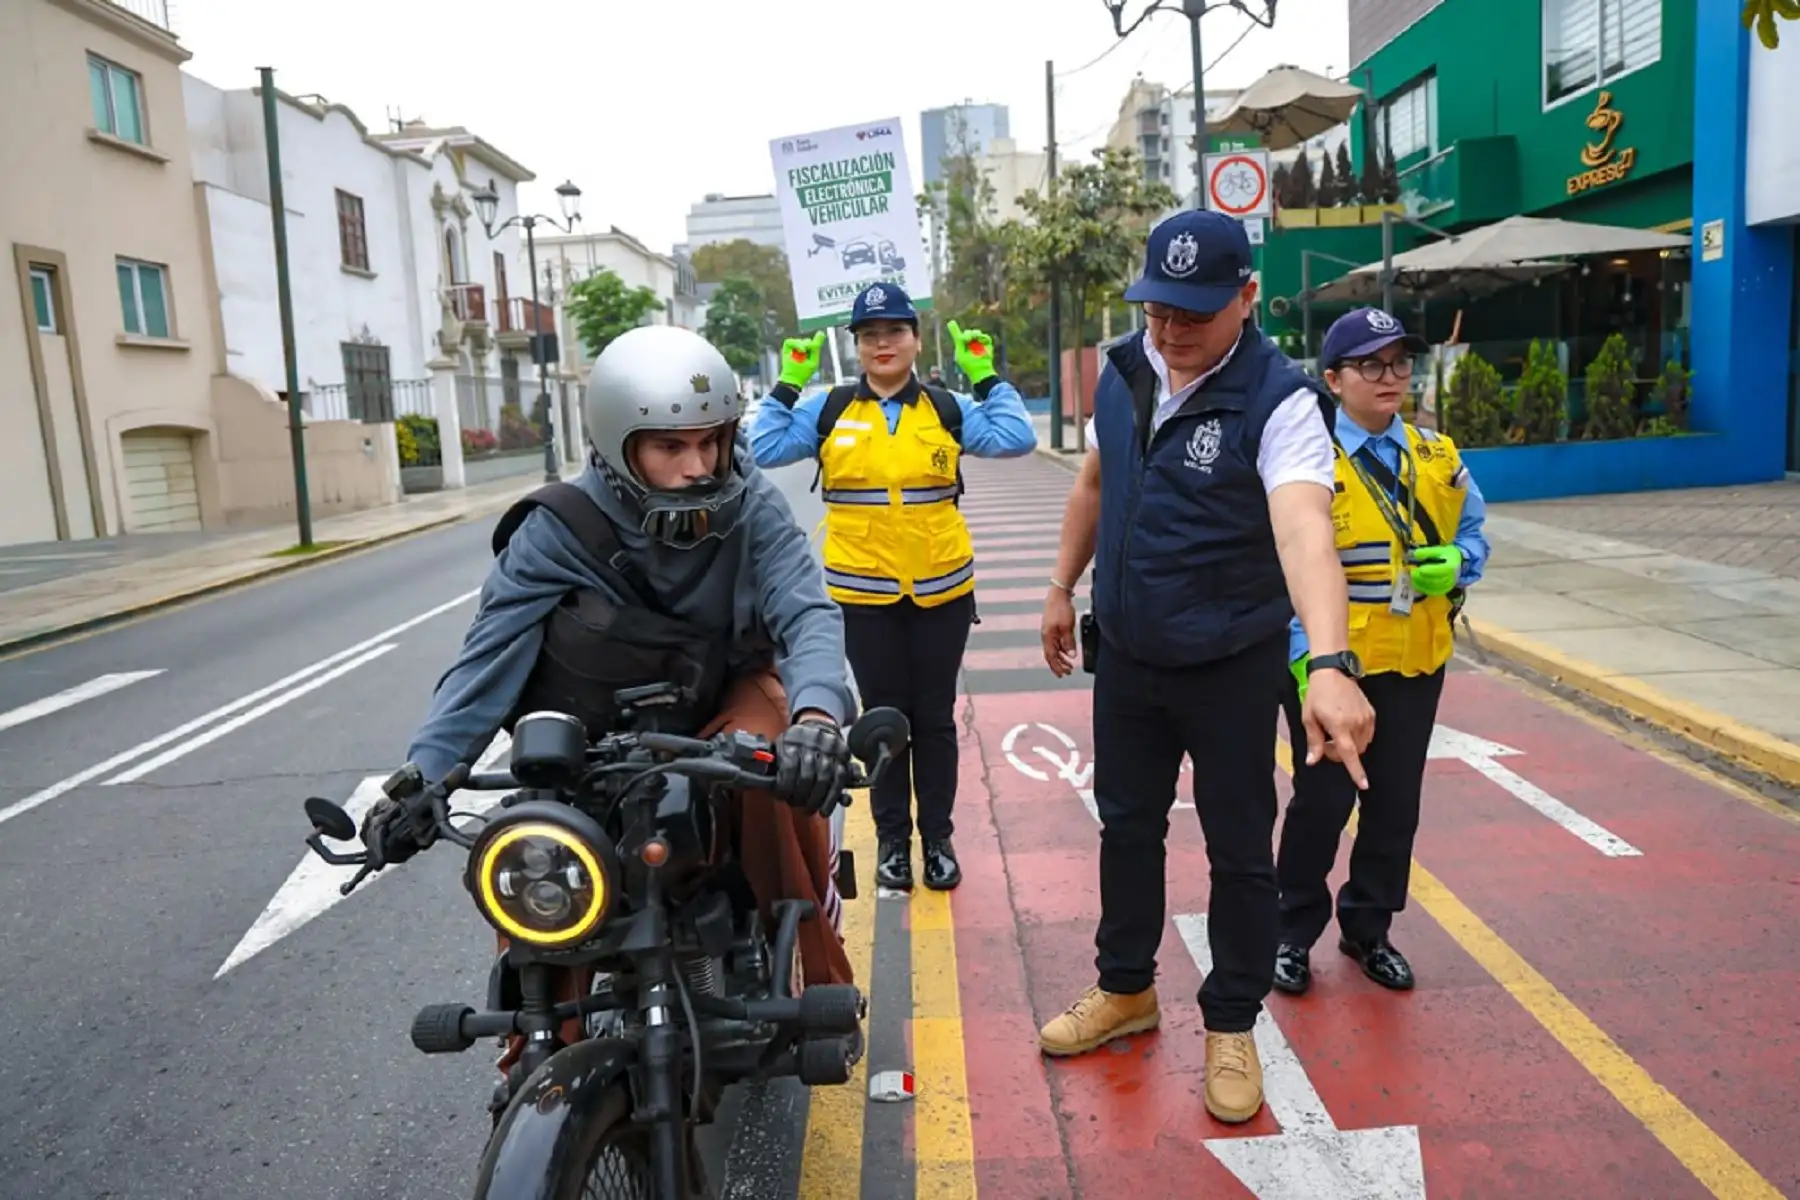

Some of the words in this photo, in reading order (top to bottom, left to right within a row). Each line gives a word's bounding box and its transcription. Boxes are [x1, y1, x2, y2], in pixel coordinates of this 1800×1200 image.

[788, 149, 895, 188] FISCALIZACIÓN
[804, 176, 886, 205] ELECTRÓNICA
[808, 196, 889, 226] VEHICULAR
[818, 282, 855, 301] EVITA
